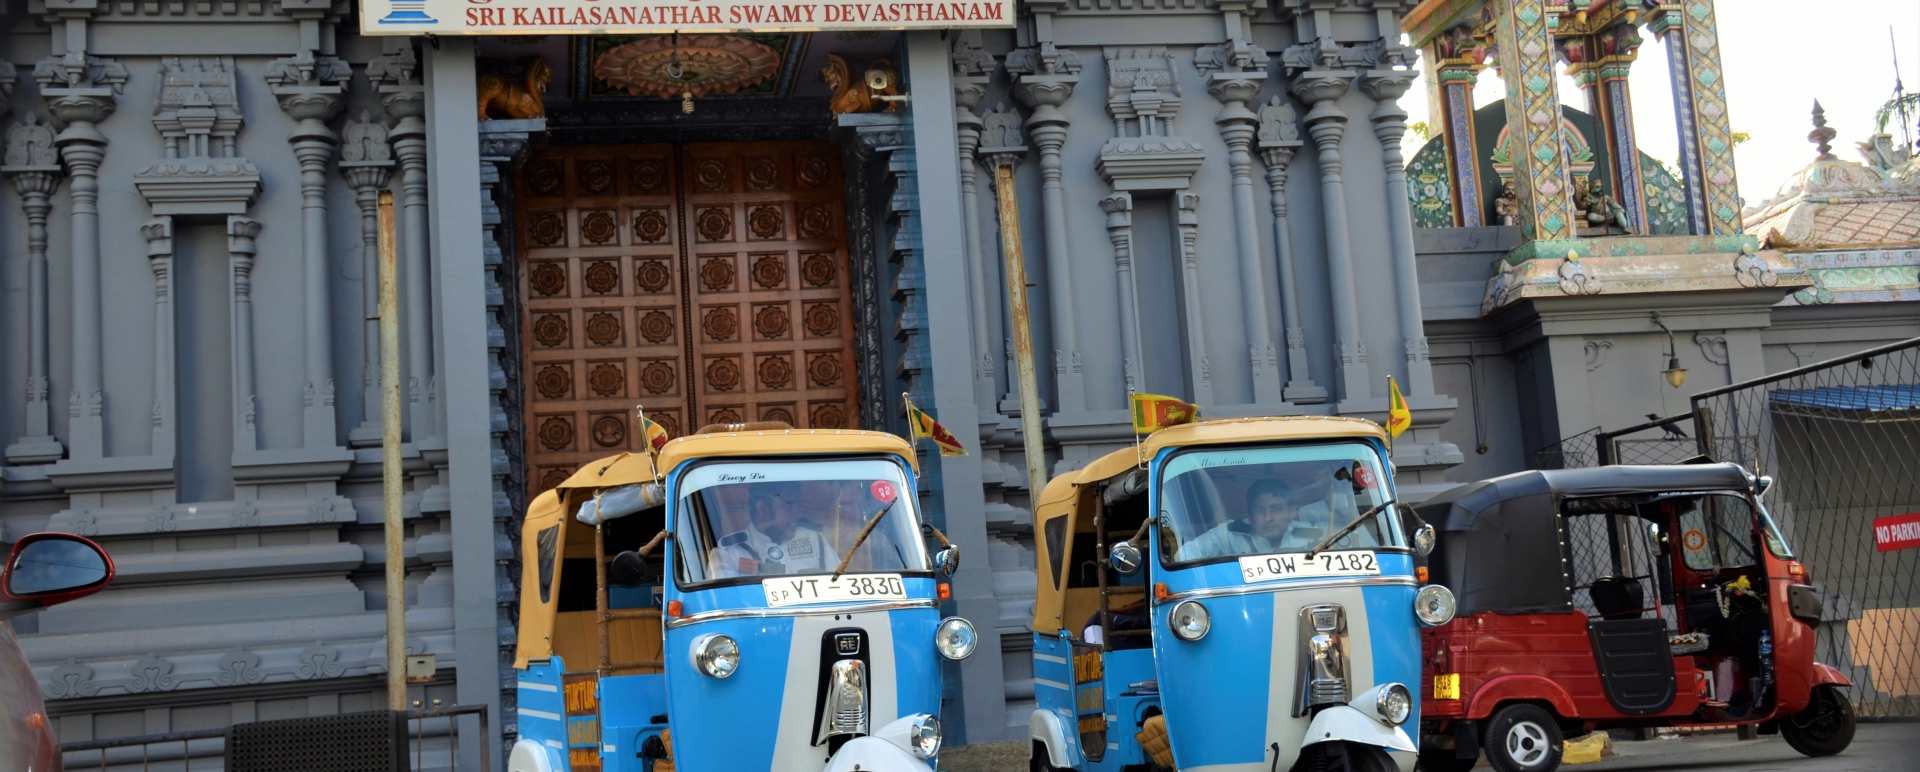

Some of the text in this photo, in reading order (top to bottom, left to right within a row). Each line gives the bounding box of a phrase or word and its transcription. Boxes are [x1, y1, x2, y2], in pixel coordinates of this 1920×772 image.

[466, 2, 1004, 26] SRI KAILASANATHAR SWAMY DEVASTHANAM
[1875, 525, 1891, 544] NO
[1266, 556, 1297, 575] QW
[1319, 553, 1377, 572] 7182
[790, 579, 819, 599] YT
[847, 577, 903, 596] 3830
[839, 640, 857, 652] RE
